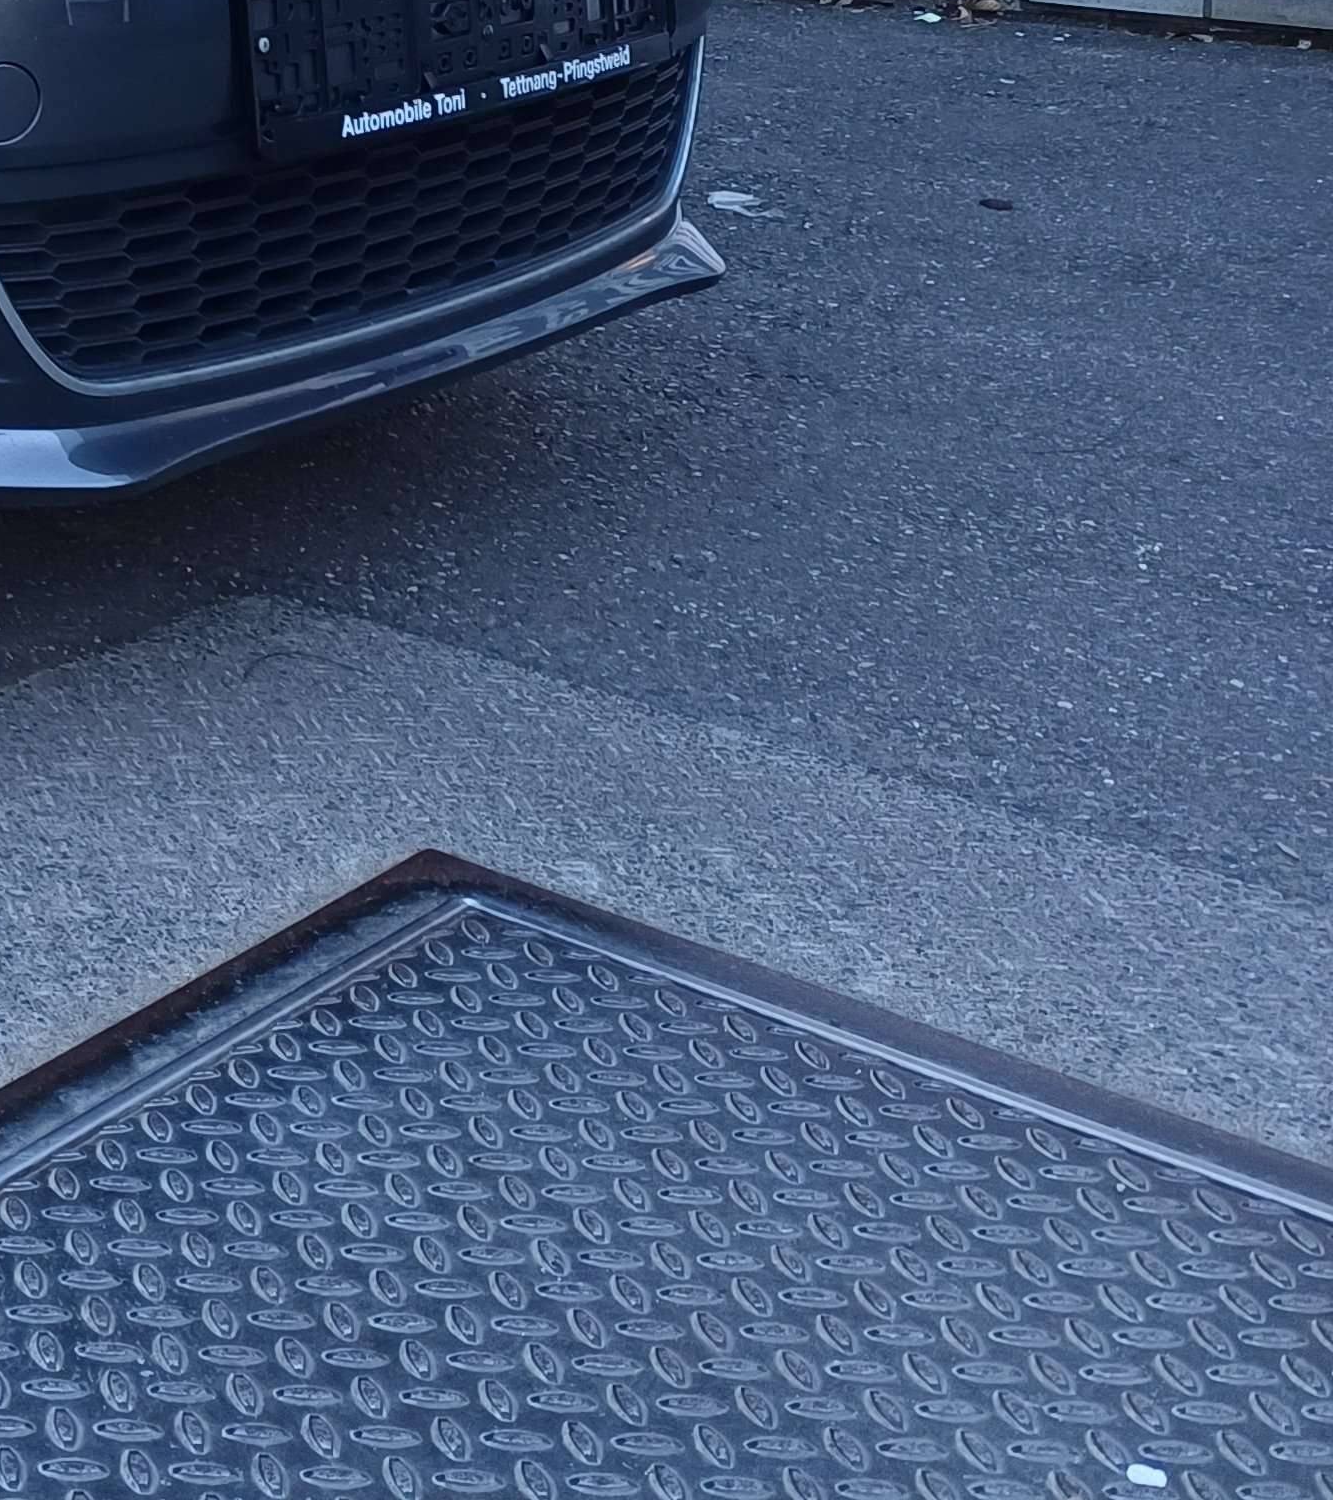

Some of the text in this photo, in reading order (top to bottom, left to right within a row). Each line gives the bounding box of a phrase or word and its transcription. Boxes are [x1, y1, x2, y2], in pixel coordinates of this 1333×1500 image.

[341, 44, 631, 138] Automobile Toni Tettnang-Pfingstweid
